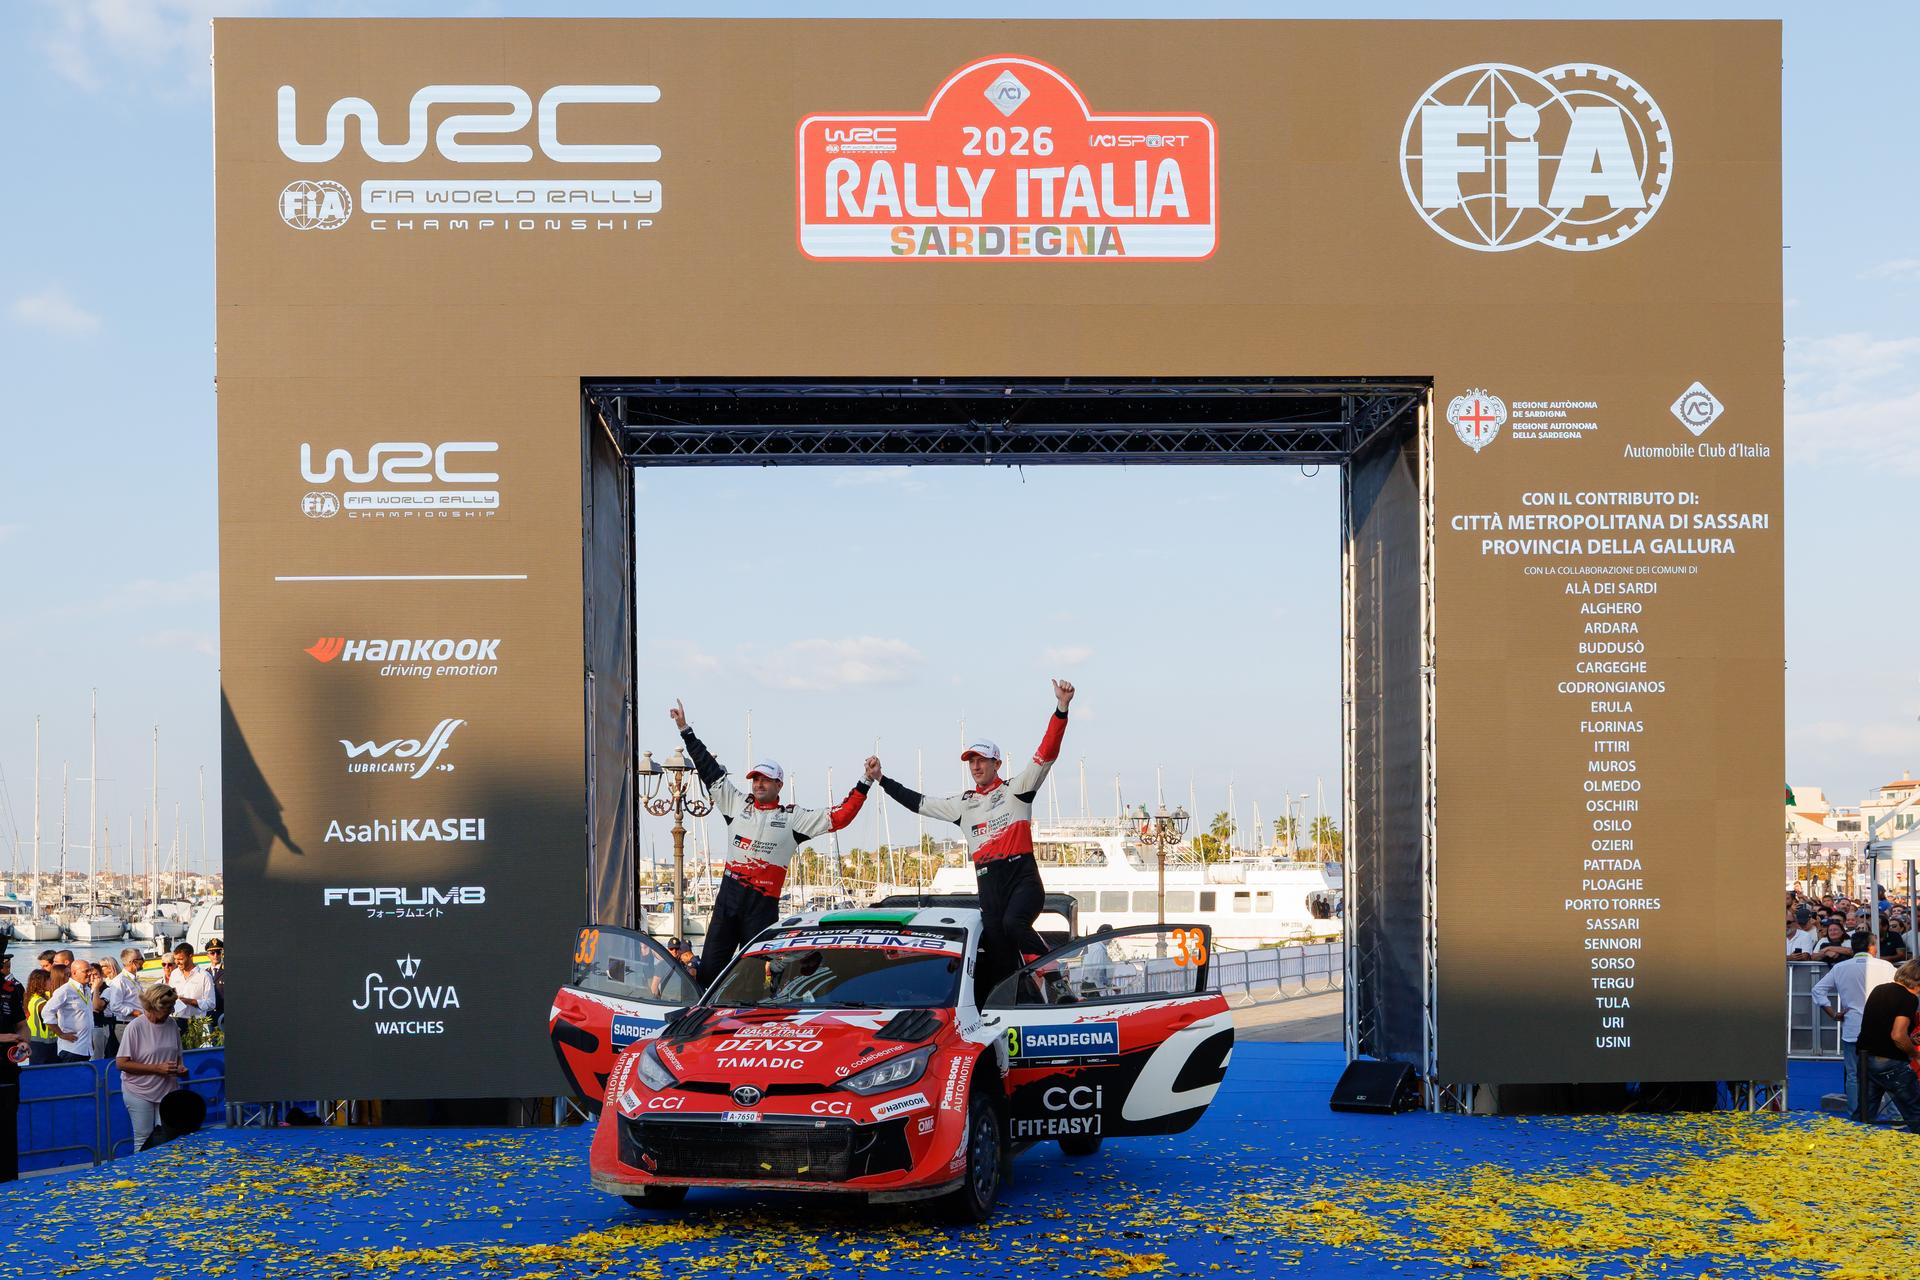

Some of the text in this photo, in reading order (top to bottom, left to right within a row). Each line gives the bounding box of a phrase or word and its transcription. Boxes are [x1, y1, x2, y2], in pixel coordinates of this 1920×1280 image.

[278, 85, 662, 162] WRC
[824, 127, 897, 142] WRC
[962, 126, 1054, 156] 2026
[825, 157, 1190, 218] RALLY ITALIA
[370, 190, 653, 203] FIA WORLD RALLY
[370, 219, 653, 230] CHAMPIONSHIP
[891, 226, 1126, 256] SARDEGNA
[1549, 400, 1598, 409] AUTÒNOMA
[1524, 410, 1567, 418] SARDIGNA
[1549, 422, 1598, 430] AUTONOMA
[1538, 431, 1582, 439] SARDEGNA
[1624, 443, 1770, 458] Automobile Club d'Italia
[301, 442, 499, 484] WRC
[348, 495, 495, 504] FIA WORLD RALLY
[1522, 491, 1699, 506] CON IL CONTRIBUTO DI:
[1451, 512, 1769, 531] CITTÀ METROPOLITANA DI SASSARI
[1482, 538, 1735, 555] PROVINCIA DELLA GALLURA
[1524, 566, 1698, 575] CON LA COLLABORAZIONE DEI COMUNI DI
[1565, 580, 1657, 594] ALÀ DEI SARDI
[1580, 602, 1642, 614] ALGHERO
[1584, 622, 1639, 634] ARDARA
[1579, 640, 1645, 654] BUDDUSÒ
[380, 663, 498, 679] driving emotion
[1576, 661, 1647, 673] CARGEGHE
[1558, 681, 1666, 693] CODRONGIANOS
[1591, 701, 1633, 713] ERULA
[1580, 721, 1644, 733] FLORINAS
[1594, 740, 1630, 752] ITTIRI
[348, 762, 416, 774] LUBRICANTS
[1588, 760, 1636, 772] MUROS
[1583, 780, 1641, 792] OLMEDO
[1586, 800, 1638, 811] OSCHIRI
[324, 818, 485, 843] AsahiKASEI
[1593, 819, 1632, 832] OSILO
[1591, 839, 1634, 851] OZIERI
[1583, 859, 1642, 871] PATTADA
[1582, 879, 1644, 890] PLOAGHE
[324, 886, 486, 906] FORUM8
[1565, 898, 1661, 910] PORTO TORRES
[366, 908, 444, 918] フォーラムエイト
[1586, 918, 1640, 930] SASSARI
[901, 930, 944, 939] Racing
[575, 929, 599, 964] 33
[789, 935, 947, 950] FORUM8
[1172, 928, 1207, 967] 33
[1584, 938, 1641, 950] SENNORI
[1591, 957, 1635, 969] SORSO
[1591, 977, 1634, 989] TERGU
[352, 972, 460, 1010] STOWA
[1595, 997, 1630, 1008] TULA
[375, 1021, 444, 1034] WATCHES
[1602, 1017, 1624, 1028] URI
[714, 1039, 823, 1052] DENSO
[1026, 1032, 1114, 1047] SARDEGNA
[1596, 1036, 1631, 1048] USINI
[851, 1044, 905, 1068] codebeamer
[717, 1058, 804, 1069] TAMADIC
[606, 1052, 630, 1107] AUTOMOTIVE
[941, 1056, 962, 1110] Panasonic
[954, 1056, 973, 1112] AUTOMOTIVE
[919, 1119, 934, 1132] OMP
